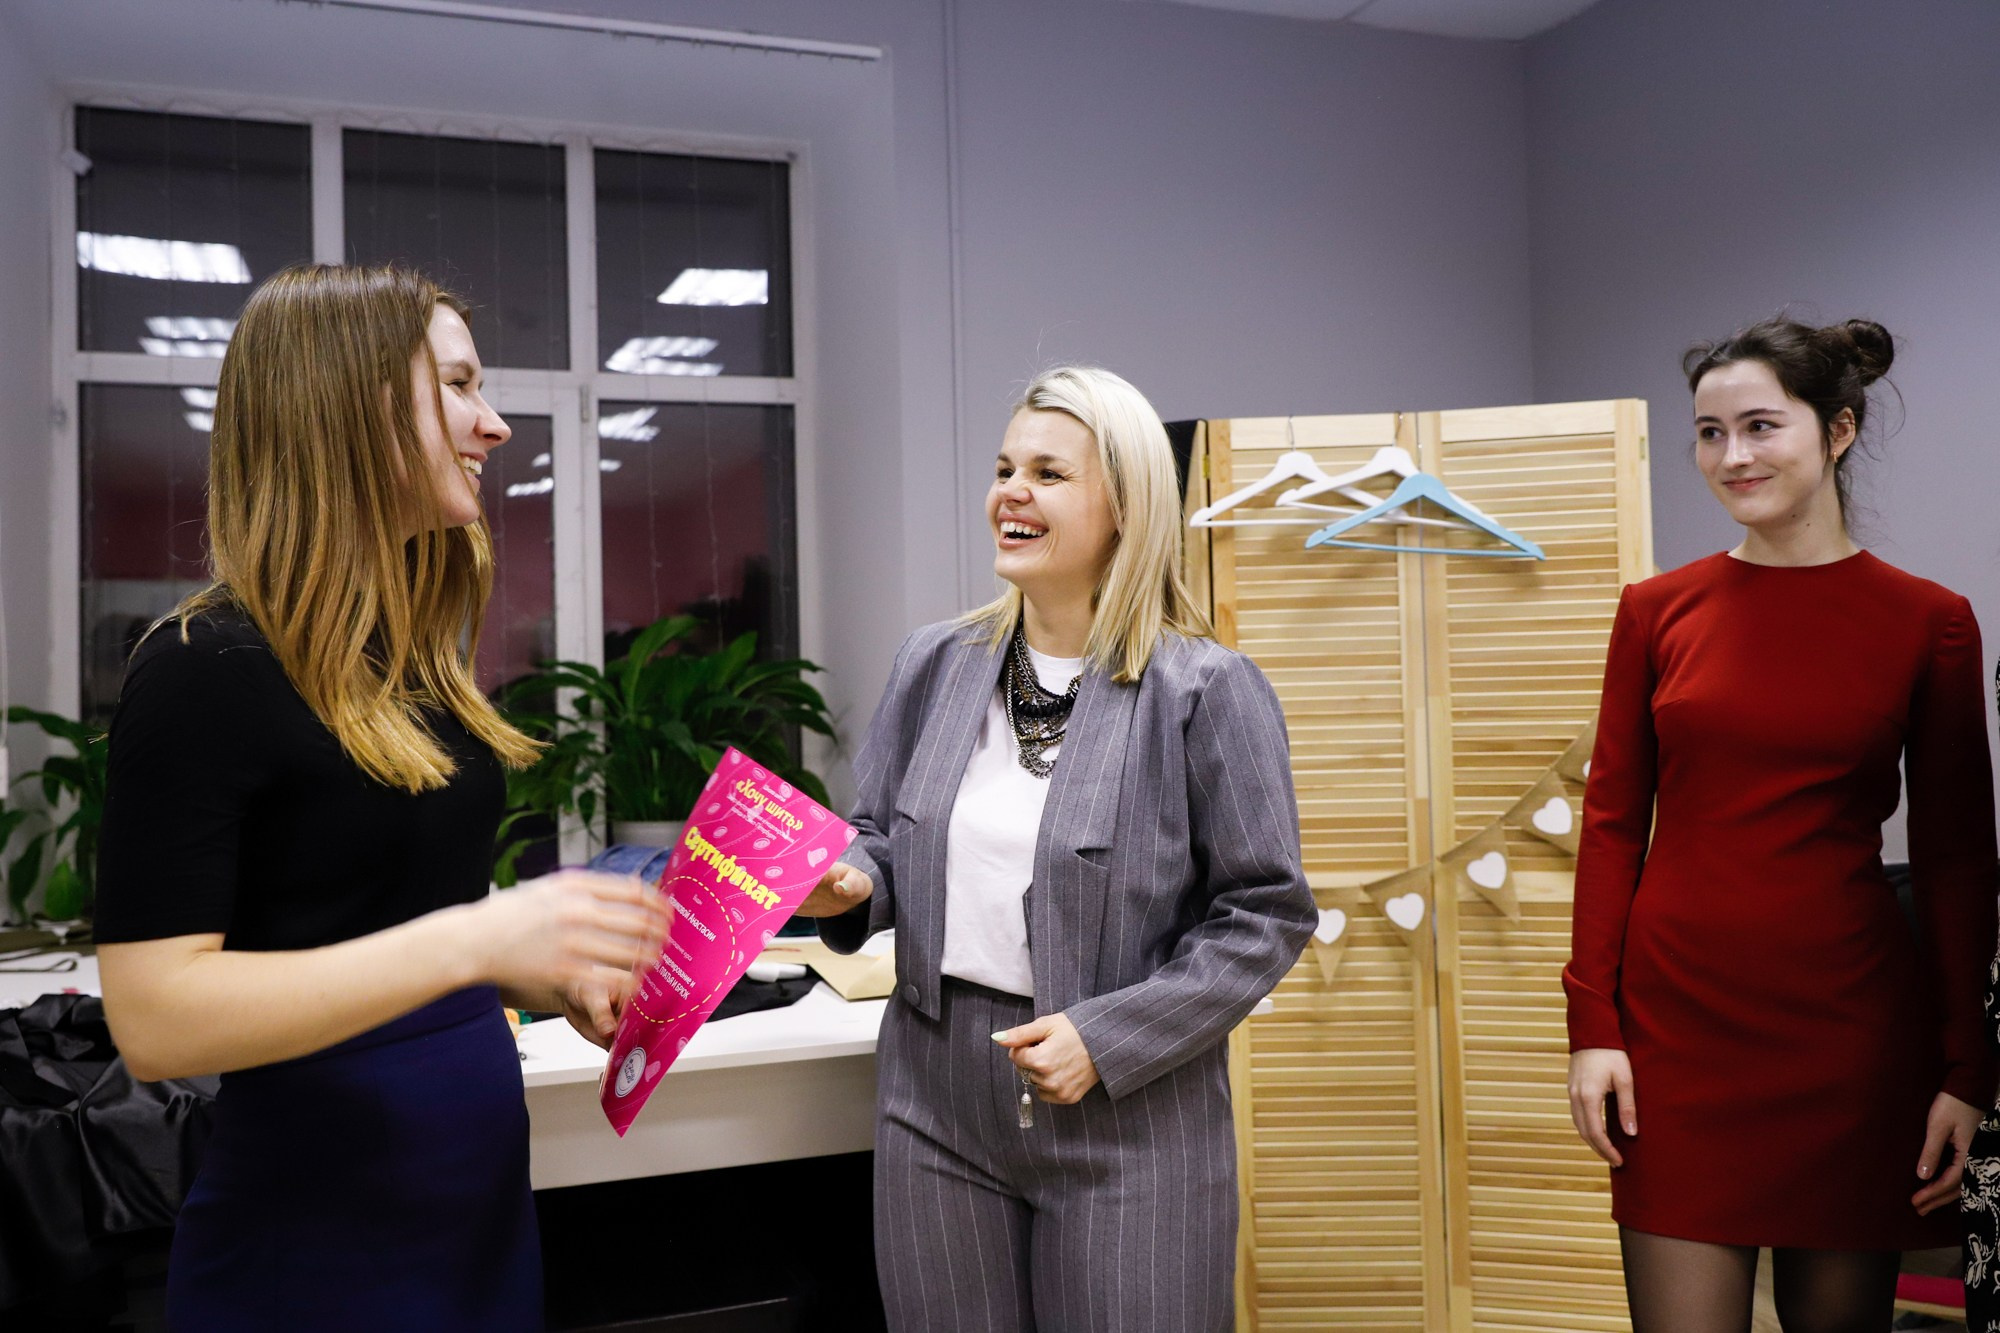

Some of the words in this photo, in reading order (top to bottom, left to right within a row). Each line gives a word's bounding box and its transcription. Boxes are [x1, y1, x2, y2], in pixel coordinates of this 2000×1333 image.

[736, 779, 768, 808] «Хочу
[765, 800, 803, 831] шить»
[684, 826, 782, 910] Сертификат
[688, 913, 717, 942] Анастасии
